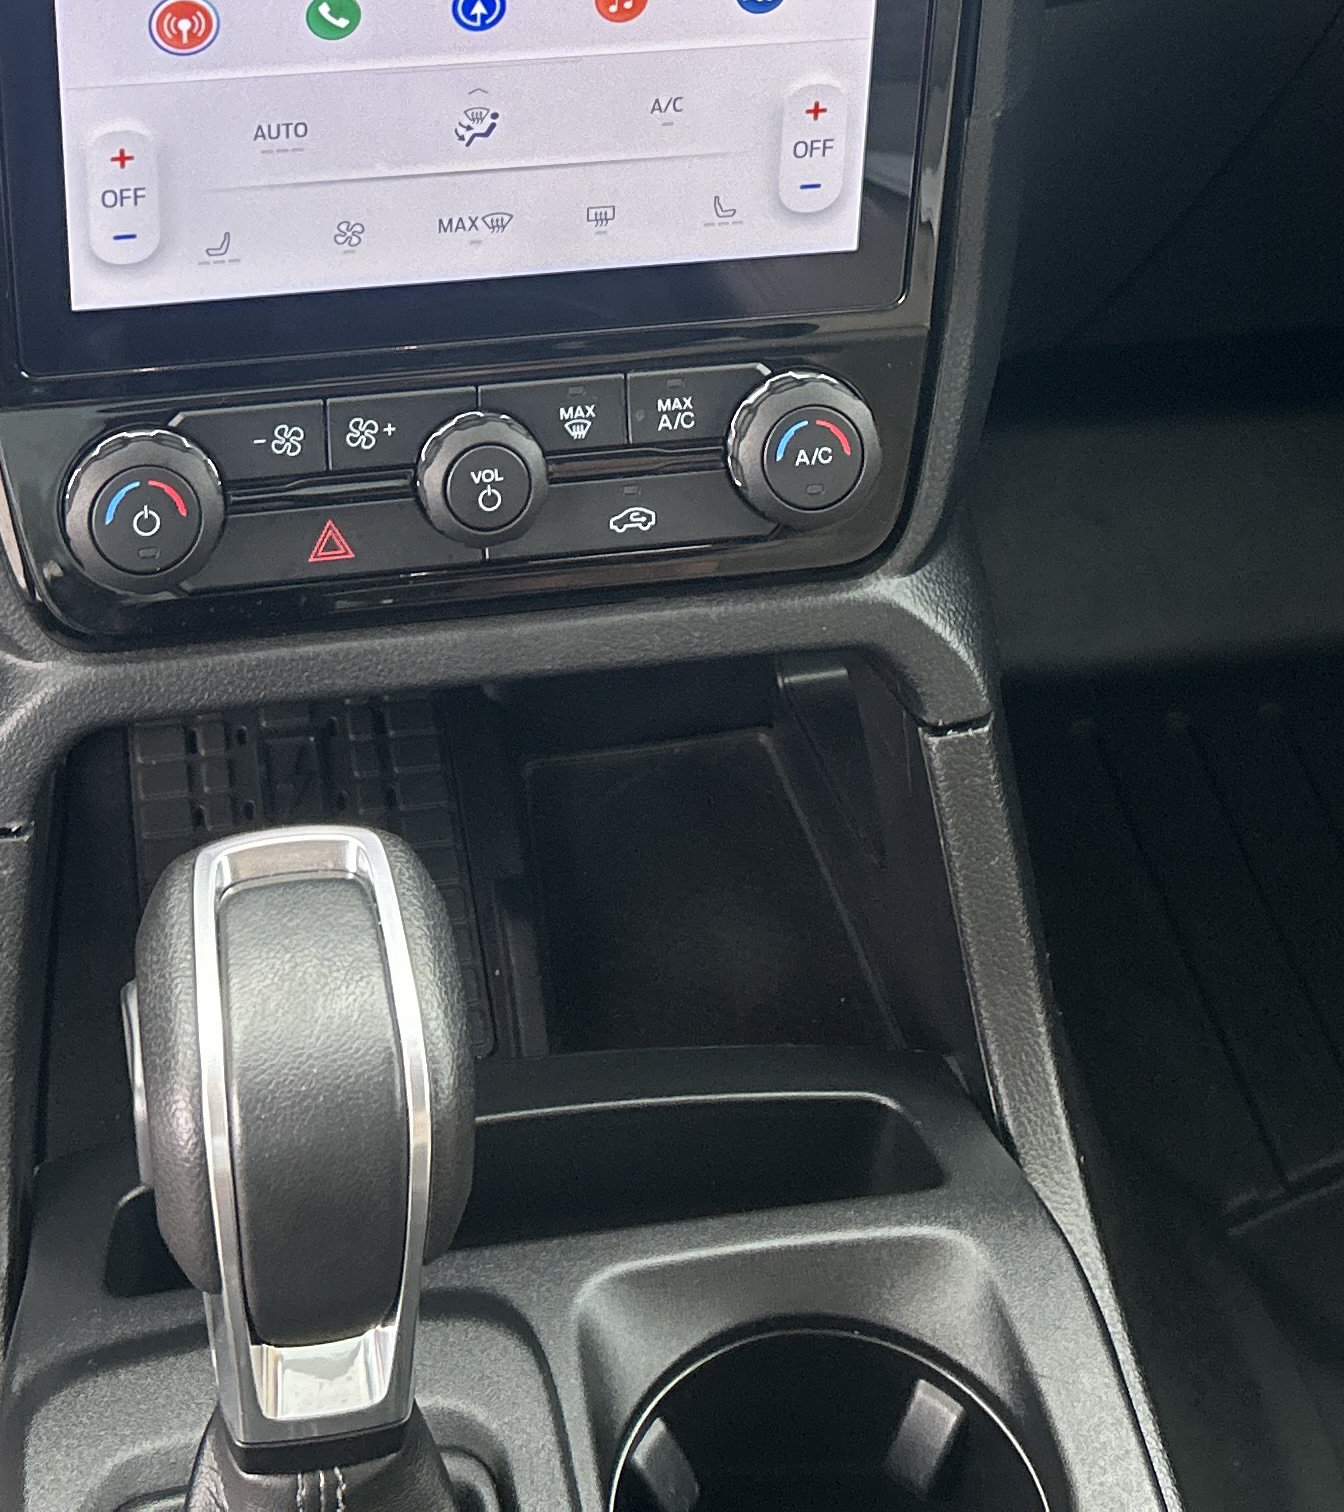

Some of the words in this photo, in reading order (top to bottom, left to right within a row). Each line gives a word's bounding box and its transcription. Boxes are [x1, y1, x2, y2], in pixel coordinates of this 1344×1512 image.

[650, 96, 684, 114] A/C
[253, 121, 309, 142] AUTO
[792, 139, 835, 159] OFF
[101, 187, 147, 209] OFF
[438, 216, 479, 234] MAX
[559, 404, 597, 420] MAX
[657, 396, 694, 413] MAX
[657, 413, 695, 431] A/C
[794, 446, 834, 466] A/C
[471, 469, 504, 484] VOL
